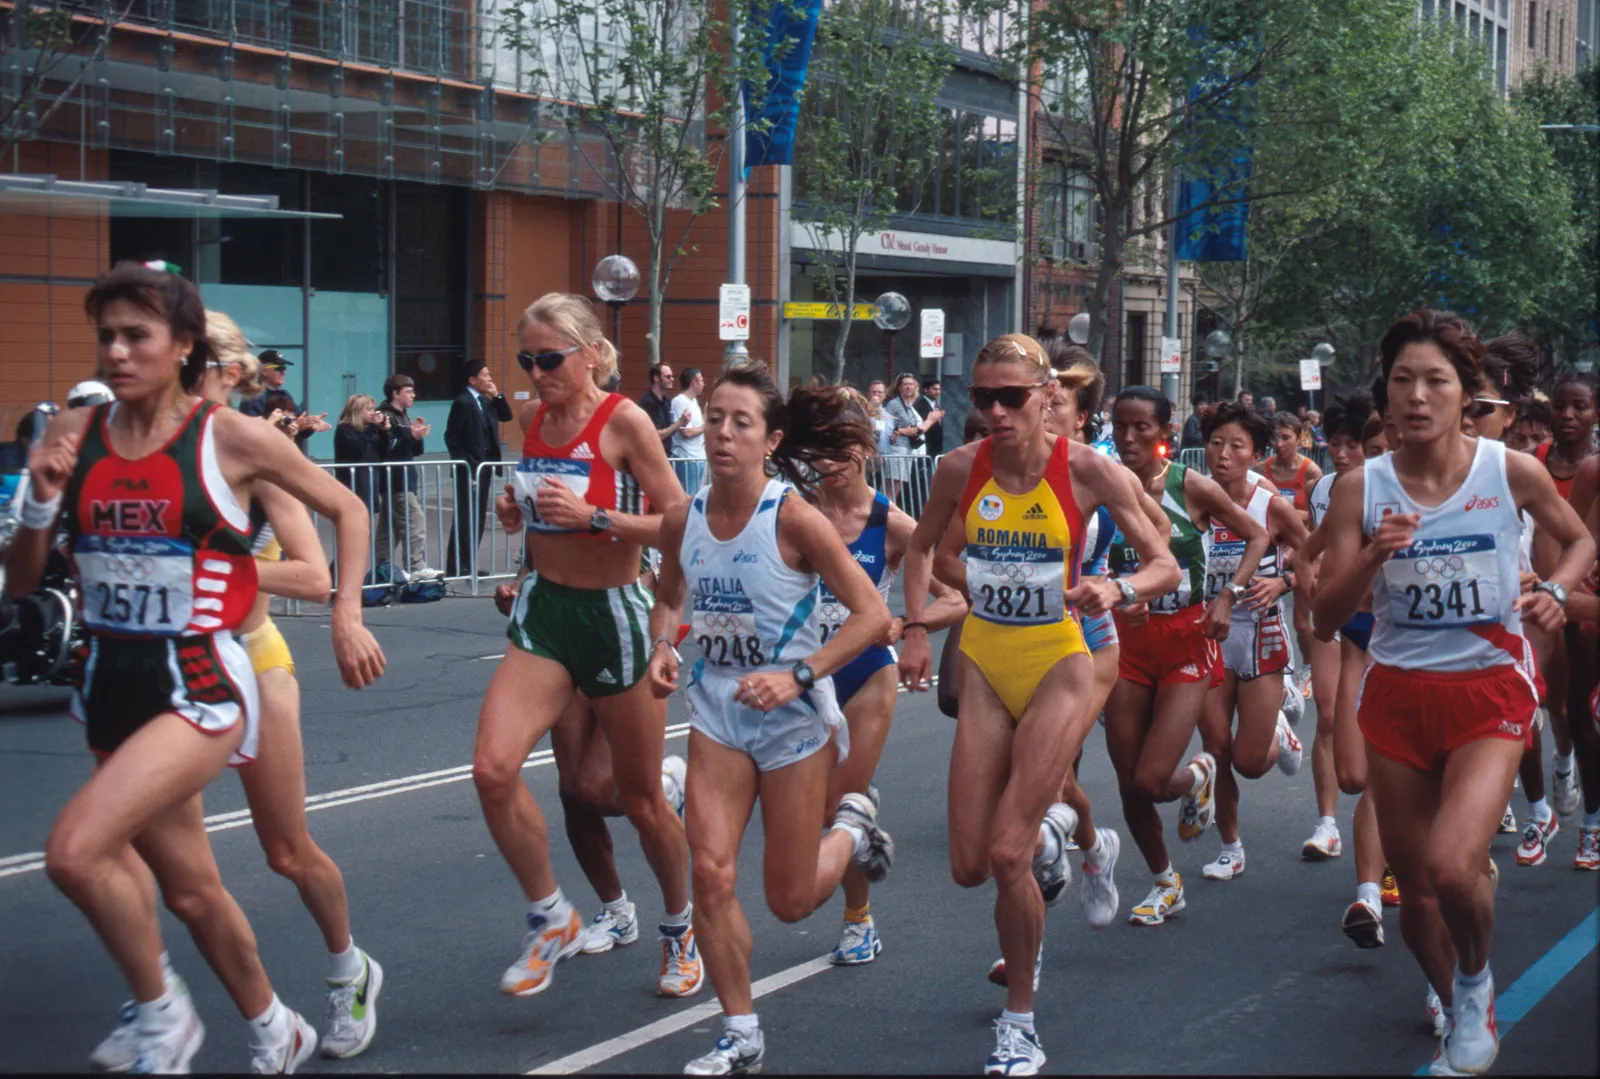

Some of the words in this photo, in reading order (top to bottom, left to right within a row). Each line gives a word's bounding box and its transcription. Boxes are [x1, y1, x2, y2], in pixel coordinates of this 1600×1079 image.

[91, 499, 171, 533] MEX
[977, 527, 1048, 548] ROMANIA
[1413, 540, 1453, 556] Sydney
[1454, 540, 1478, 553] 2000
[992, 547, 1025, 562] Sydney
[1026, 551, 1047, 561] 2000
[699, 577, 745, 595] ITALIA
[981, 584, 1048, 617] 2821
[1406, 579, 1485, 620] 2341
[97, 581, 171, 625] 2571
[698, 634, 765, 668] 2248
